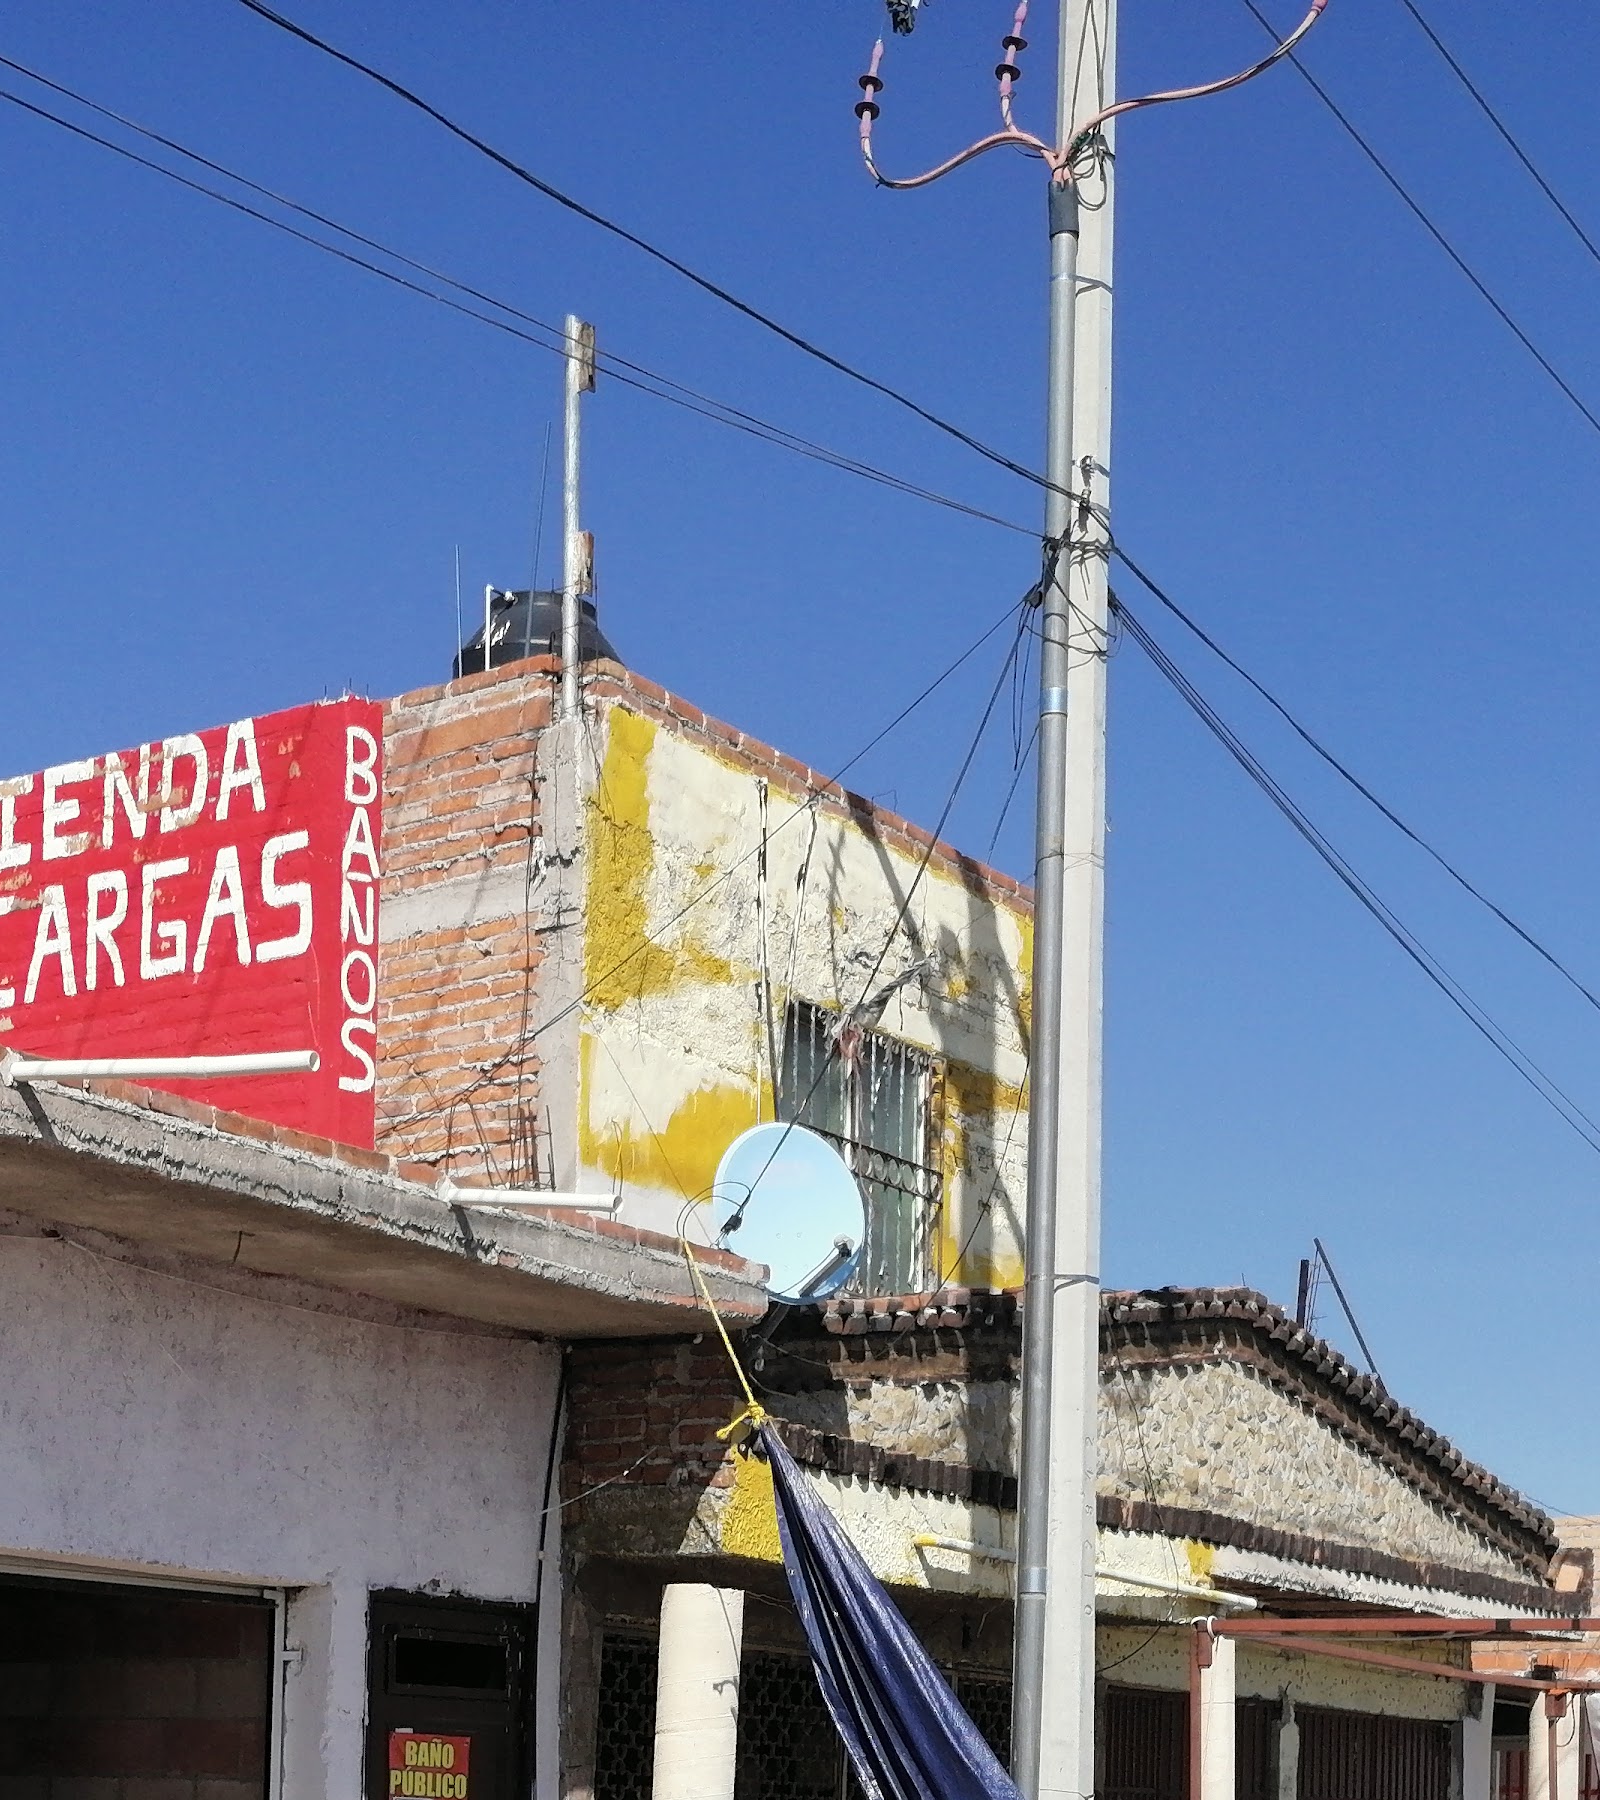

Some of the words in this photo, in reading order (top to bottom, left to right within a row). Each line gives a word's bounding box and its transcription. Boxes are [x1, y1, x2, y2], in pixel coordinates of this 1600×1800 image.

[337, 725, 380, 1094] BAÑOS
[404, 1738, 455, 1770] BAÑO
[388, 1766, 468, 1800] PÚBLICO
